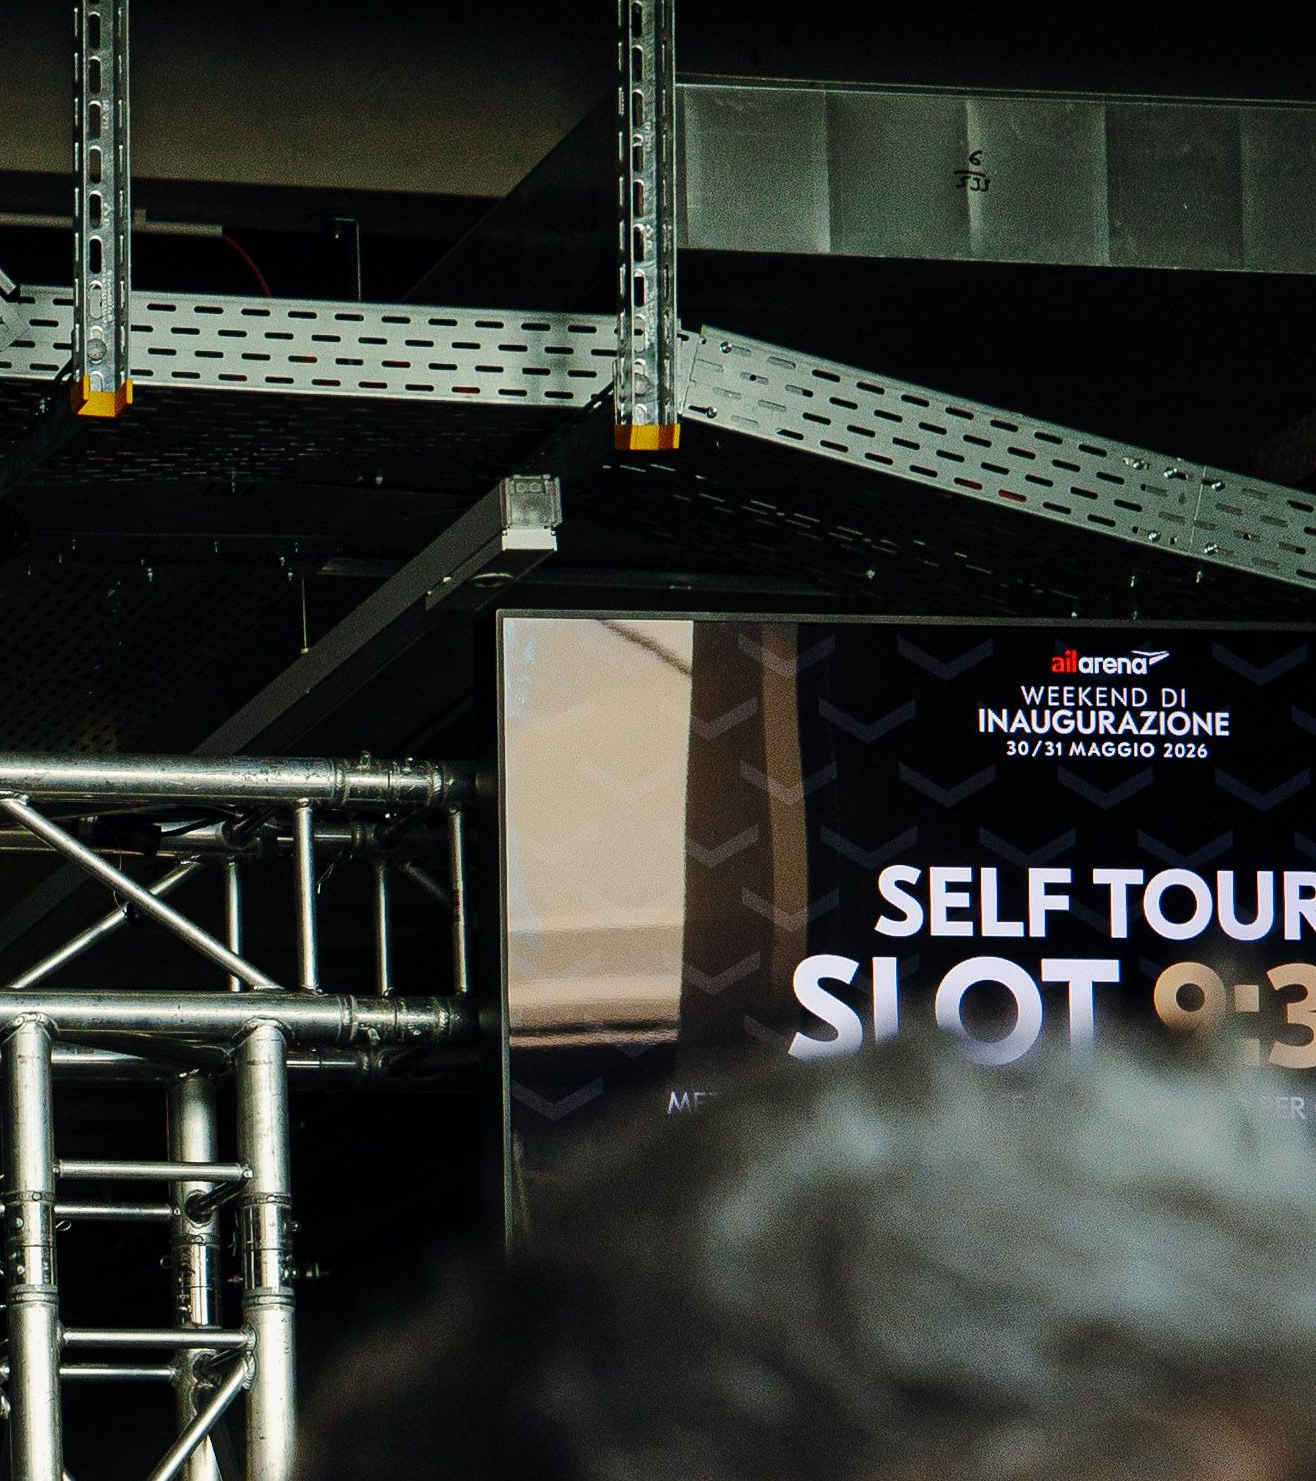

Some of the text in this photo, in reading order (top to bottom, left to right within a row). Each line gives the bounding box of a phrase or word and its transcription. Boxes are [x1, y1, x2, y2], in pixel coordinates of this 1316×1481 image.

[1020, 685, 1187, 709] WEEKEND DI
[978, 708, 1230, 737] INAUGURAZIONE
[1006, 740, 1209, 759] 30/31 MAGGIO 2026
[873, 864, 1316, 941] SELF TOUR
